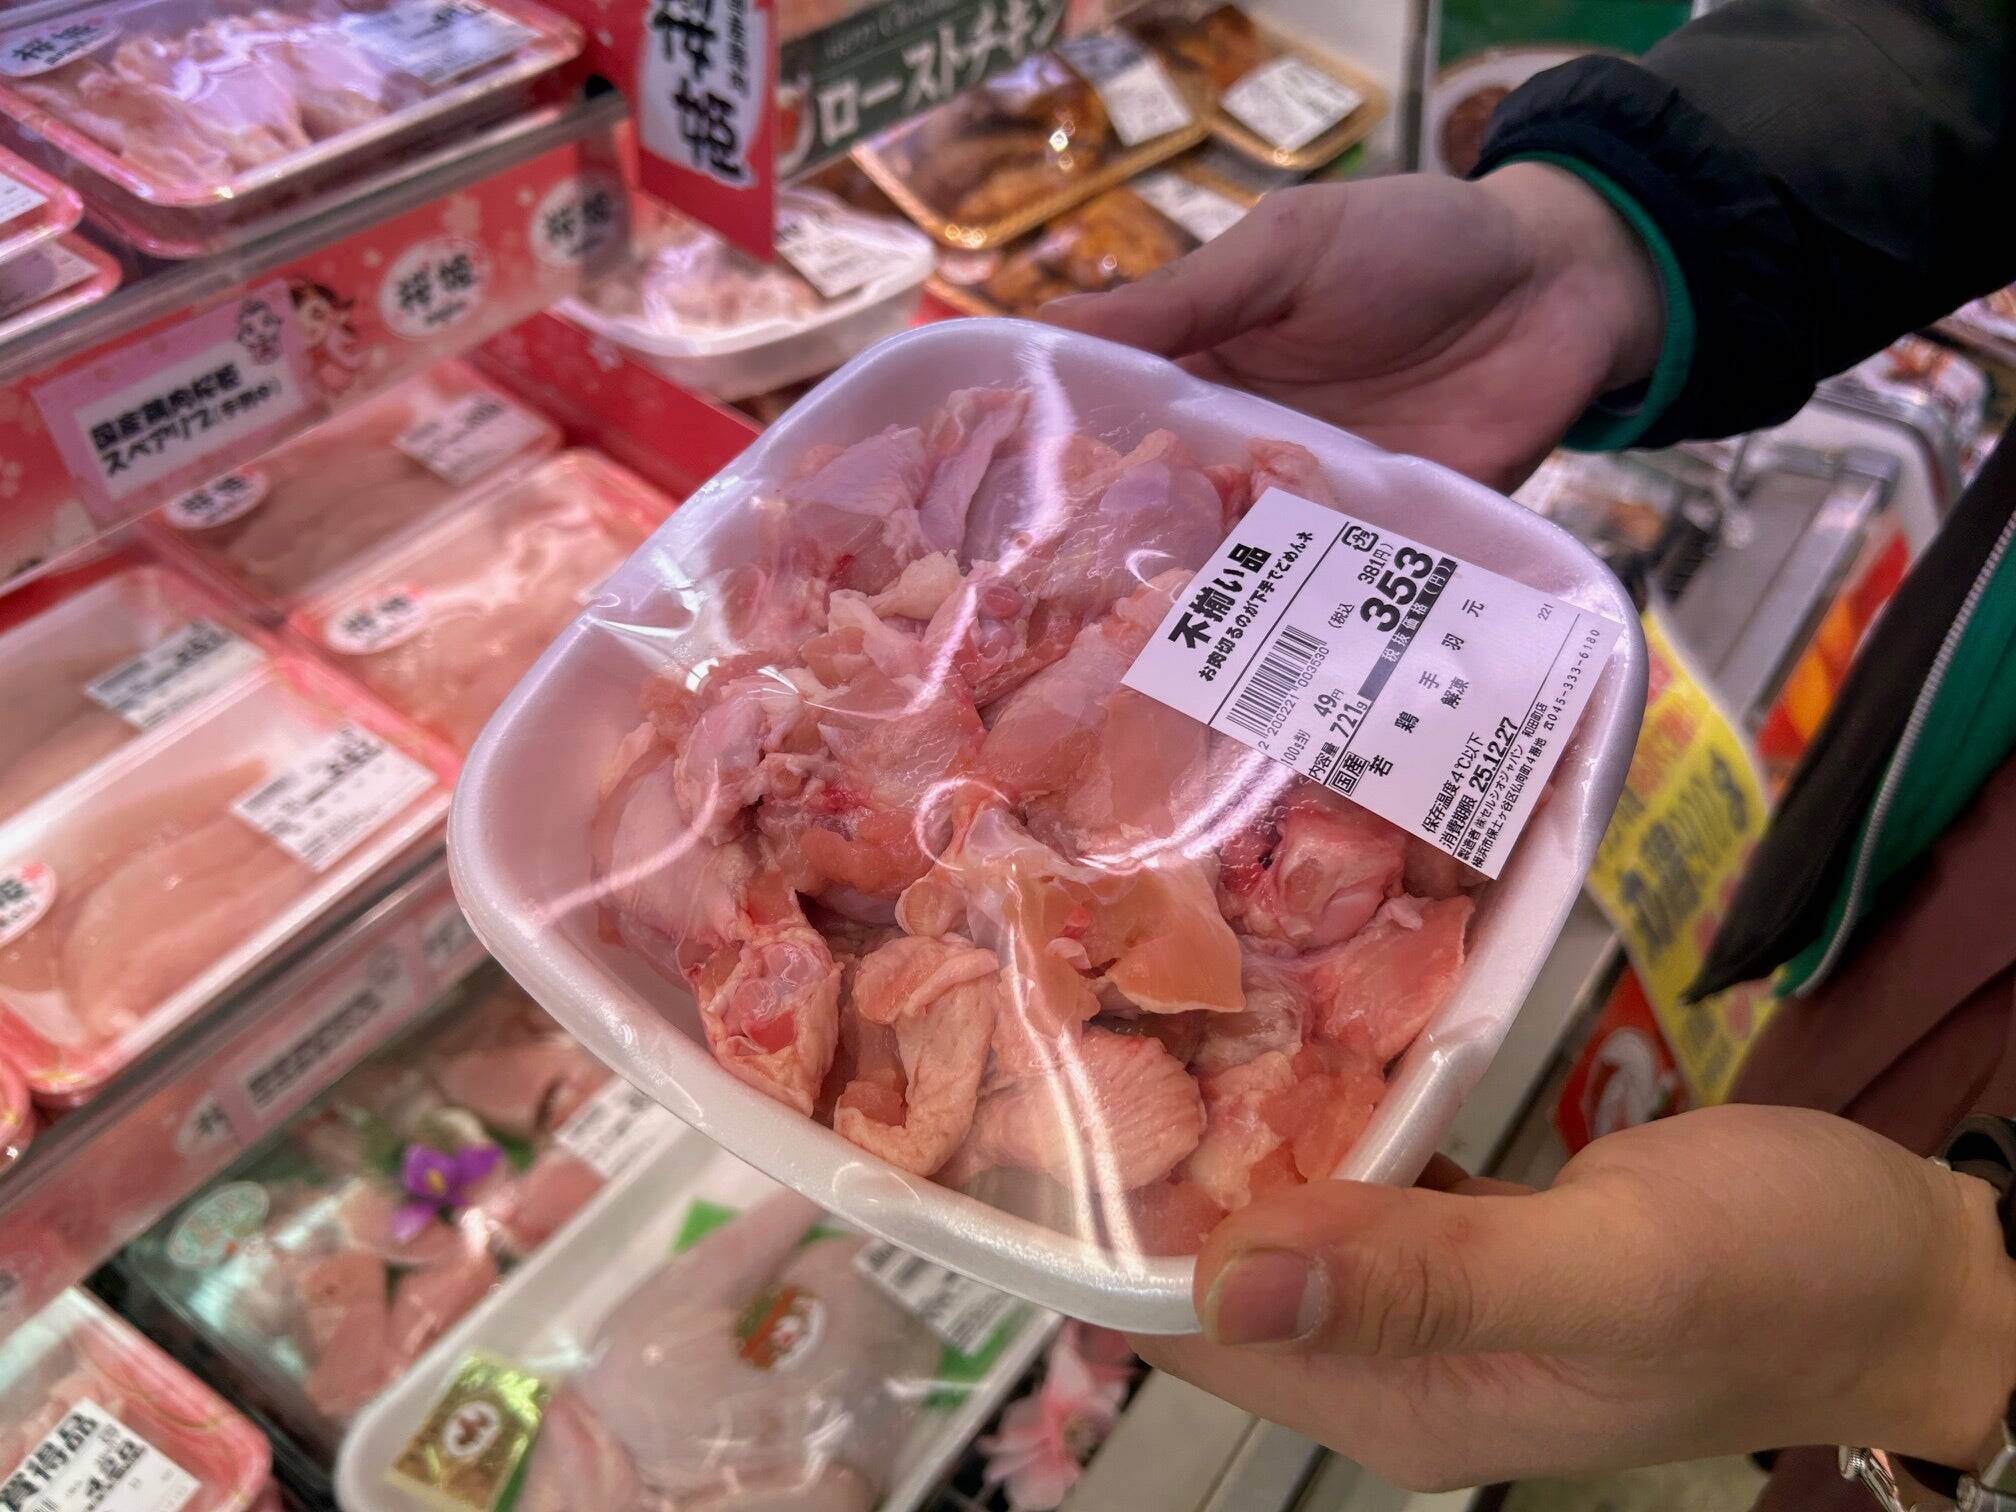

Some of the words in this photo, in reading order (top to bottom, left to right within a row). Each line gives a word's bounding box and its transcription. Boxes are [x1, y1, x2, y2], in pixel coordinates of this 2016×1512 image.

[1167, 542, 1272, 649] 不揃い品
[1198, 531, 1313, 682] お肉切るのが下手でごめんネ
[1359, 546, 1434, 632] 353
[1257, 740, 1270, 751] 2
[1266, 693, 1300, 737] 200221
[1297, 646, 1330, 688] 003530
[1307, 741, 1340, 782] 内容量
[1329, 700, 1368, 739] 721g
[1440, 677, 1470, 710] 解凍
[1331, 753, 1368, 794] 国産
[1438, 794, 1478, 850] 消費期限
[1468, 716, 1519, 794] 25.12.27
[1456, 828, 1482, 861] 製造者
[1521, 701, 1548, 738] 和田町店
